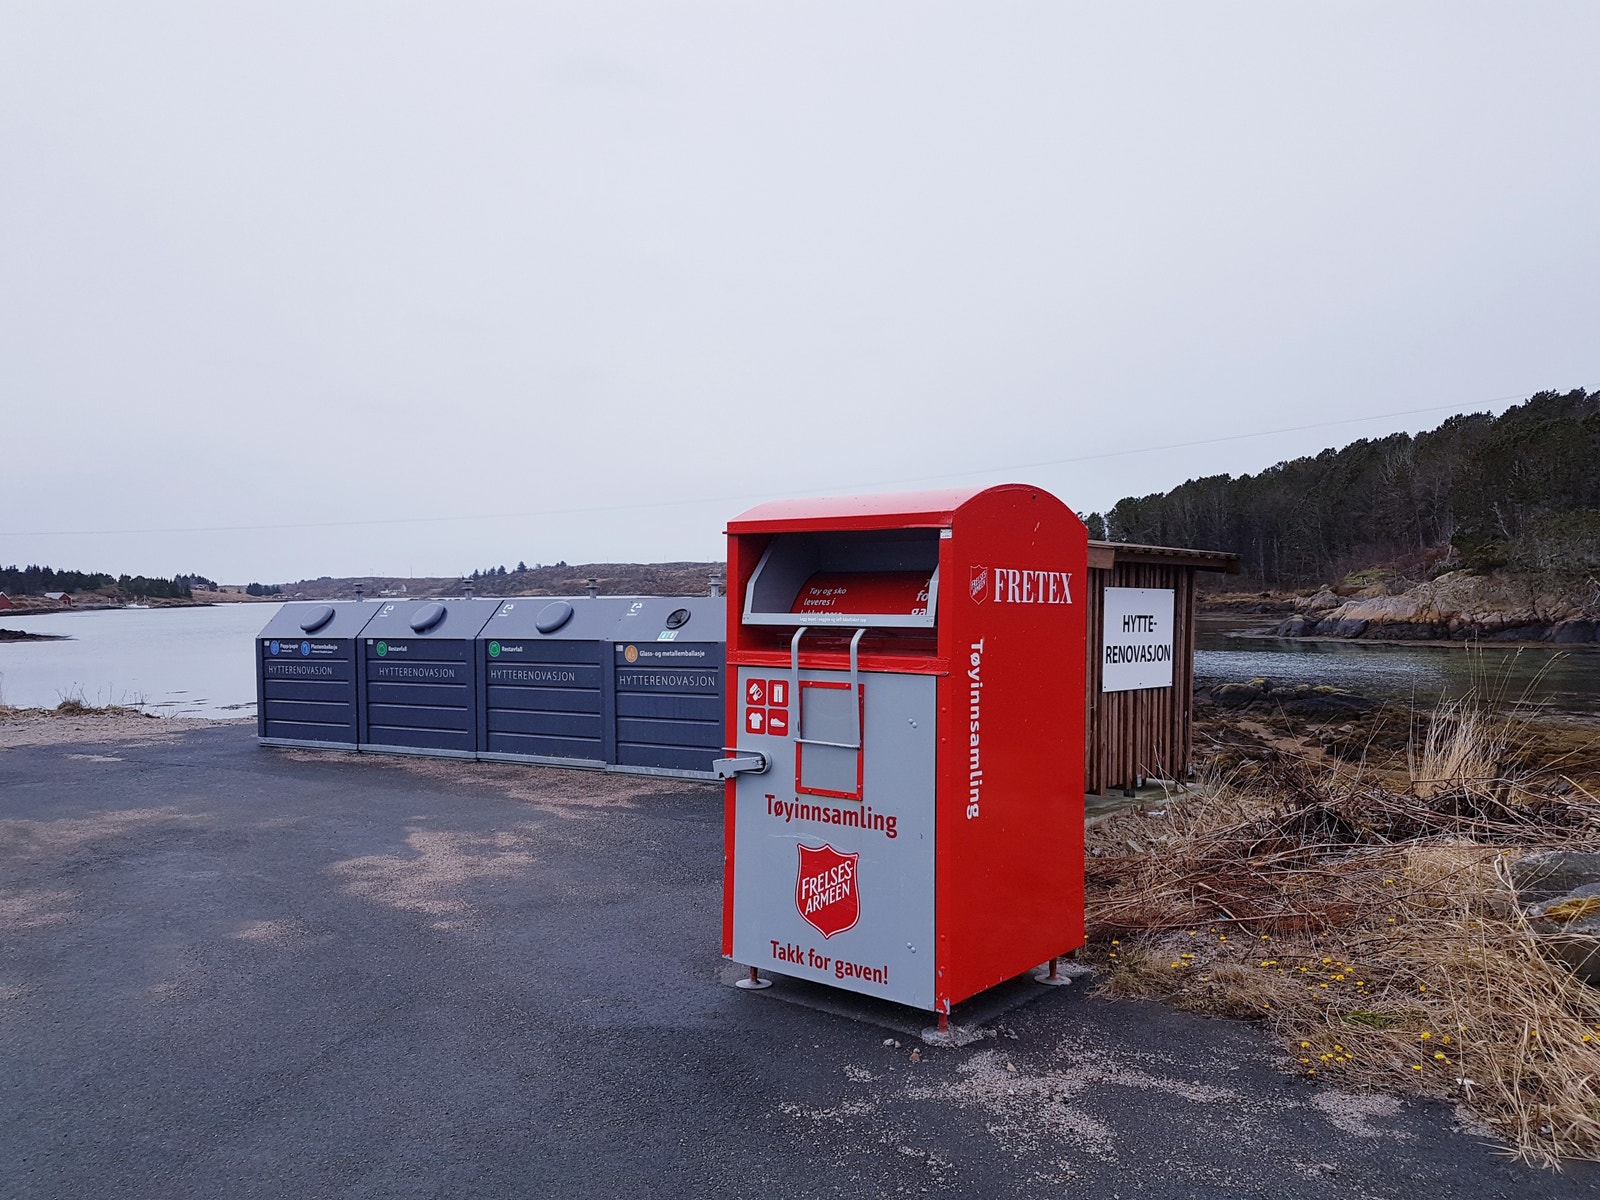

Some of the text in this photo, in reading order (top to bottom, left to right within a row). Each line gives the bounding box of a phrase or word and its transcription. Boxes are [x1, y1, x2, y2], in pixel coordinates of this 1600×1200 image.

[810, 587, 822, 596] Tøy
[833, 587, 847, 595] sko
[993, 568, 1072, 604] FRETEX
[803, 597, 836, 606] leveres i
[915, 589, 929, 602] fo
[1122, 614, 1157, 633] HYTTE-
[662, 650, 705, 658] metallemballasje
[1105, 644, 1171, 664] RENOVASJON
[268, 665, 333, 675] HYTTERENOVASJON
[379, 667, 455, 678] HYTTERENOVASJON
[490, 670, 575, 681] HYTTERENOVASJON
[619, 675, 715, 687] HYTTERENOVASJON
[966, 638, 984, 820] Tøyinnsamling
[765, 794, 898, 839] Tøyinnsamling
[802, 860, 854, 900] FRELSES-
[804, 880, 850, 916] ARMEEN
[770, 940, 889, 985] Takk for gaven!
